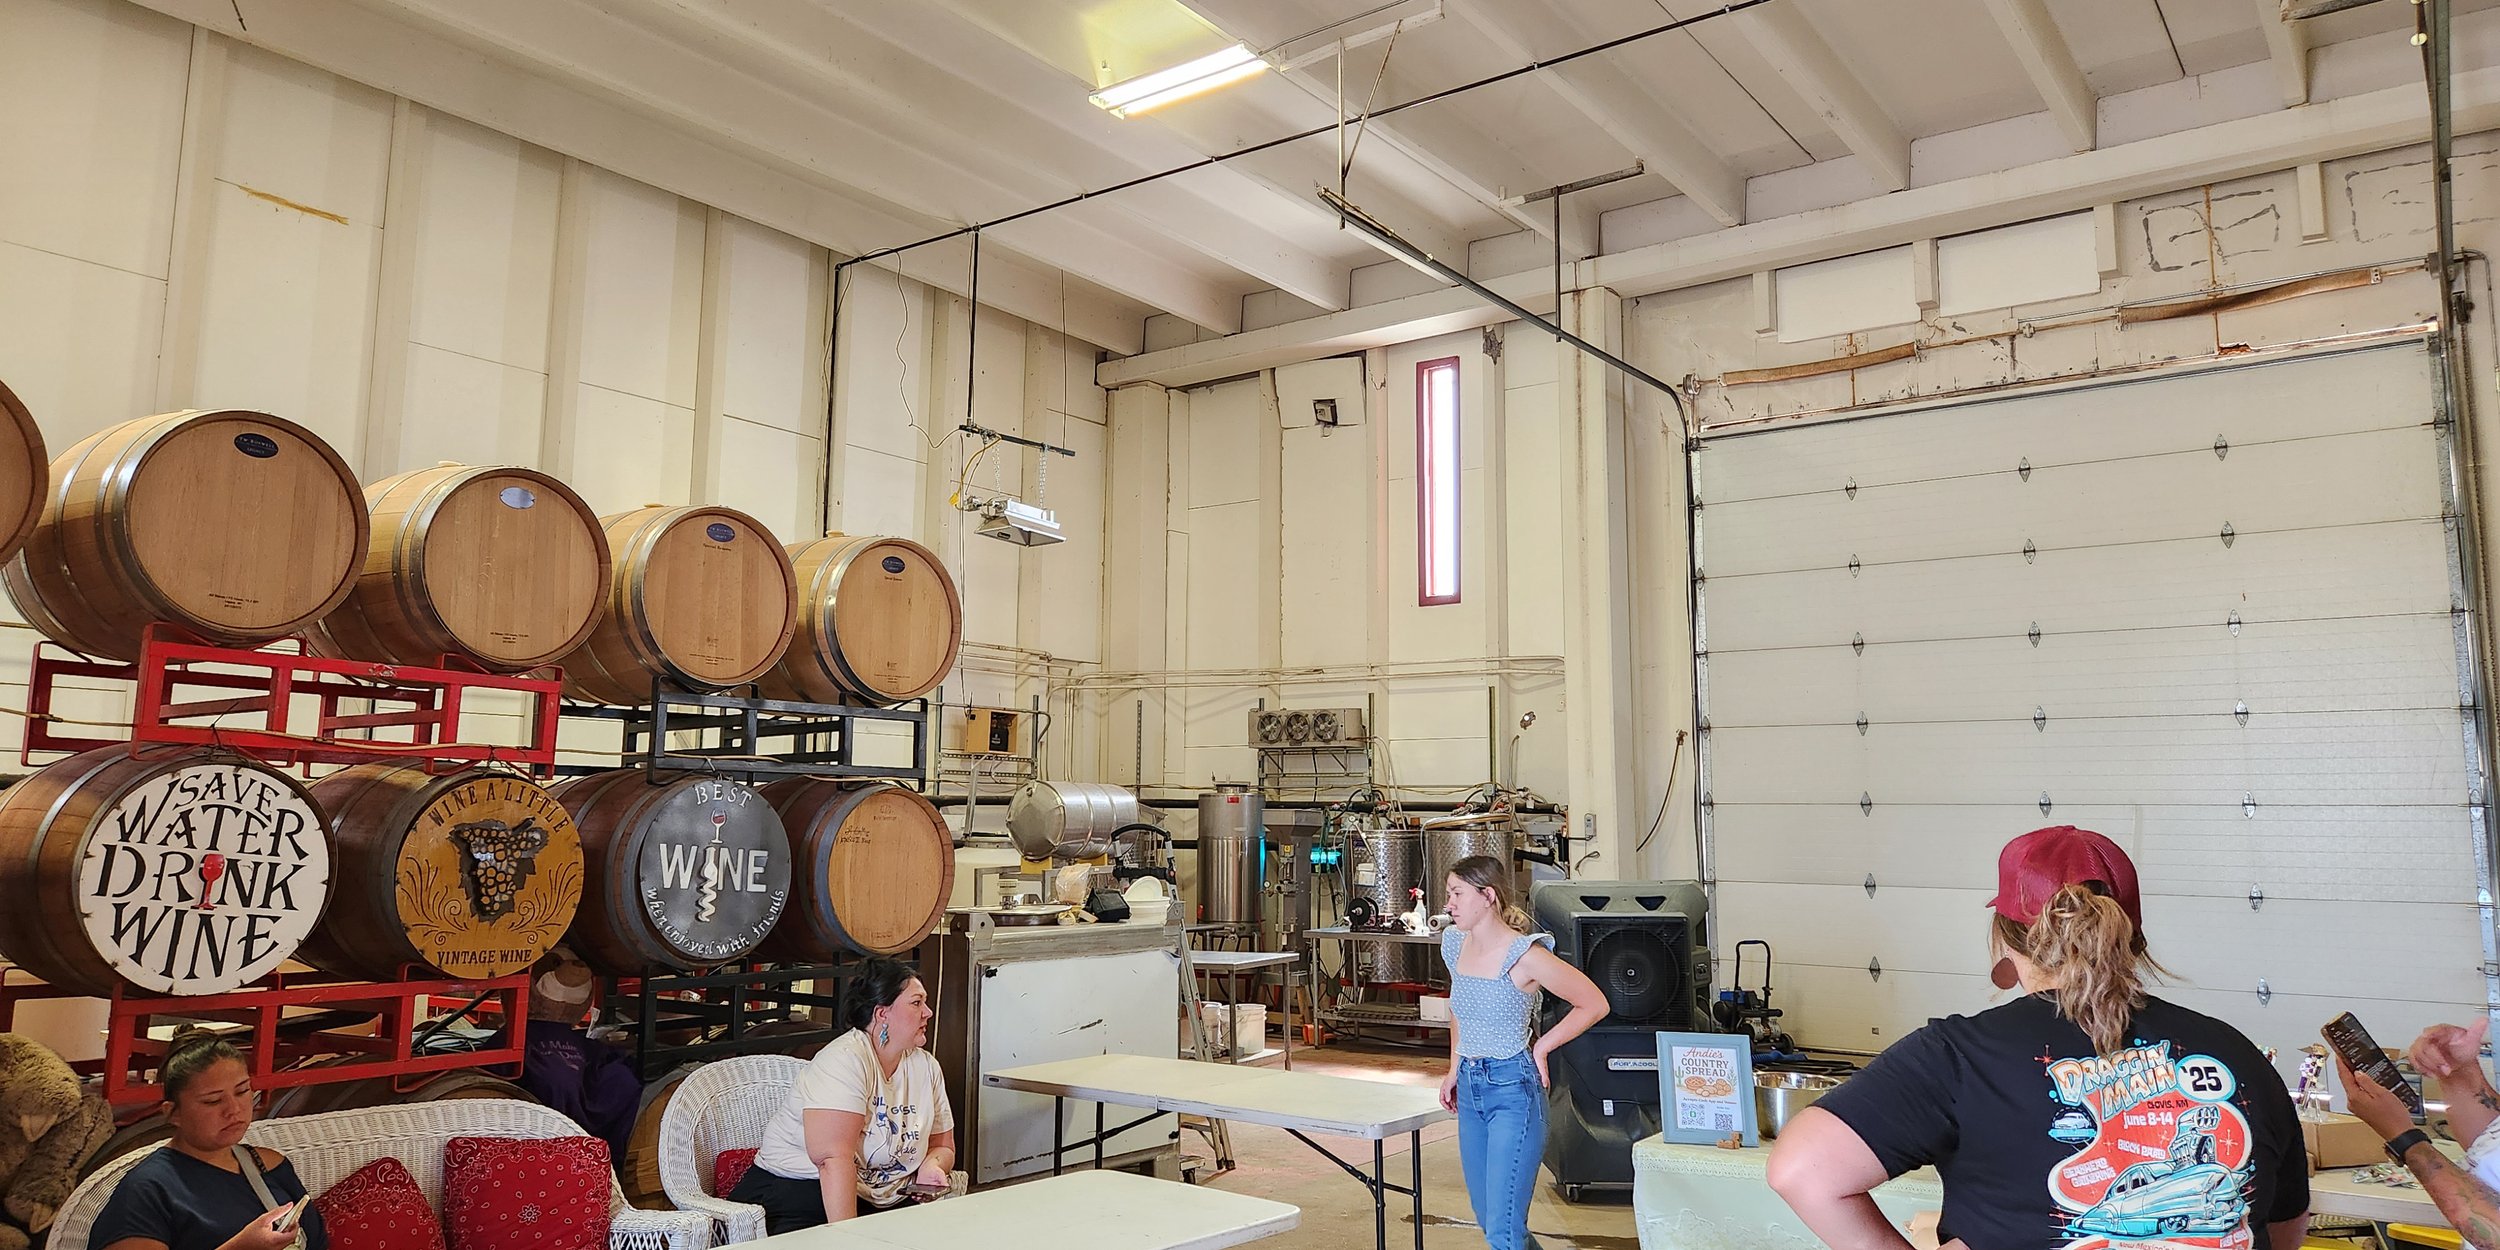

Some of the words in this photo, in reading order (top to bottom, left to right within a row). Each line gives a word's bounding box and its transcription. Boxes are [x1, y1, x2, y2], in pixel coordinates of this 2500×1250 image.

[116, 778, 310, 861] WATER
[173, 772, 279, 823] SAVE
[428, 785, 477, 827] WINE
[486, 782, 497, 801] A
[504, 782, 571, 833] LITTLE
[694, 784, 752, 808] BEST
[91, 843, 306, 912] DRINK
[659, 843, 769, 893] WINE
[110, 901, 283, 980] WINE
[646, 886, 669, 927] when
[716, 933, 751, 955] with
[436, 950, 496, 966] VINTAGE
[499, 949, 533, 963] WINE
[1681, 1058, 1729, 1070] COUNTRY
[1682, 1046, 1725, 1059] Andie's
[1685, 1067, 1727, 1078] SPREAD
[2051, 1041, 2171, 1103] DRAGGIN'
[2101, 1060, 2178, 1119] MAIN
[2180, 1065, 2223, 1093] '25
[2123, 1112, 2147, 1128] june
[2147, 1112, 2175, 1127] 8-14
